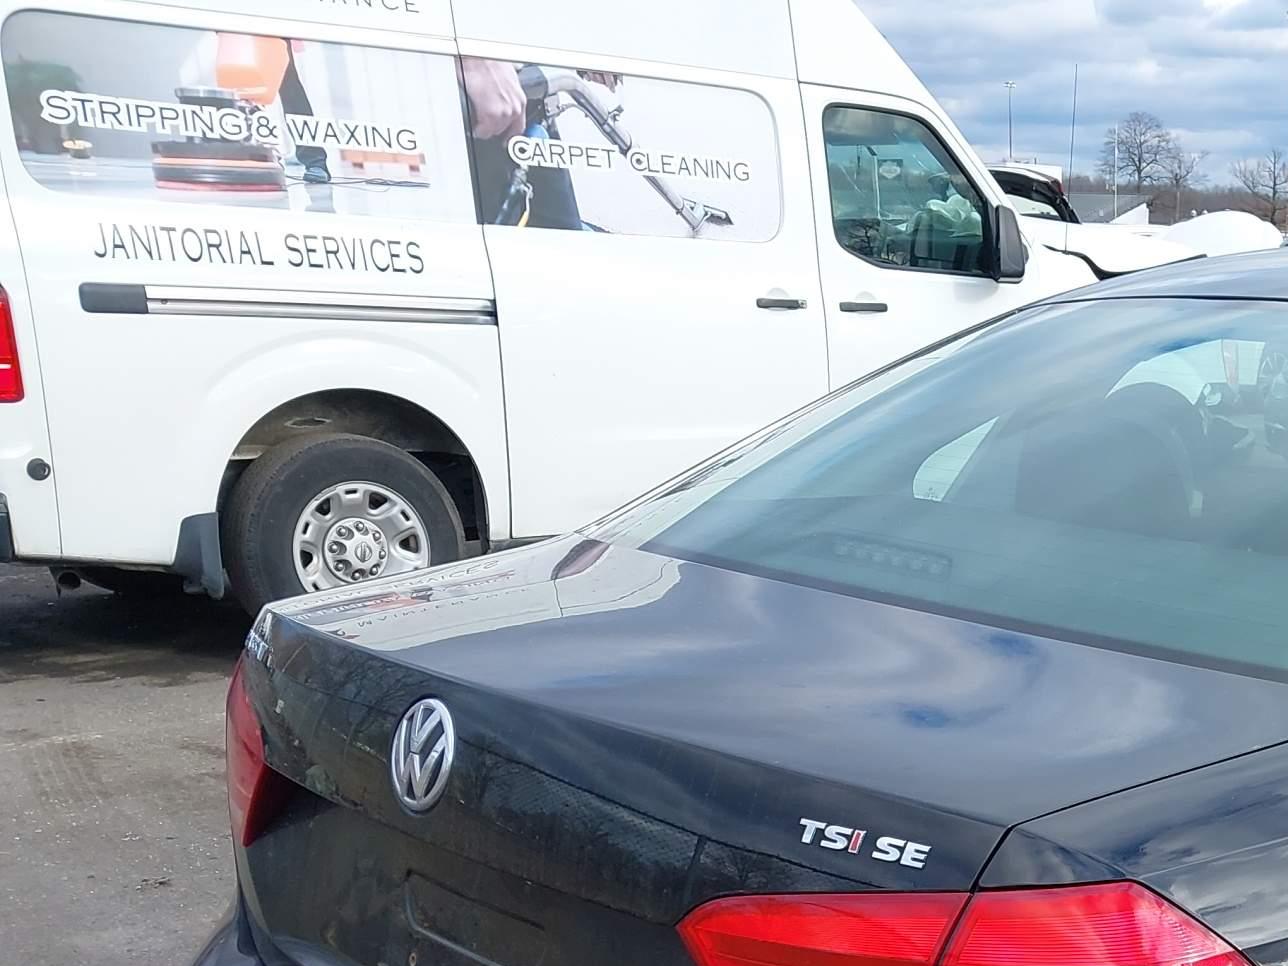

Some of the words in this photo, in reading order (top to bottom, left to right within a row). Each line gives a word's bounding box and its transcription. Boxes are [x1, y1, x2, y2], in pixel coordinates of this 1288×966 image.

[43, 93, 244, 137] STRIPPING
[254, 115, 278, 139] &
[293, 117, 418, 152] WAXING
[511, 140, 616, 169] CARPET
[629, 151, 750, 182] CLEANING
[93, 222, 275, 266] JANITORIAL
[283, 232, 425, 275] SERVICES
[799, 817, 867, 855] TSI
[871, 836, 932, 869] SE
